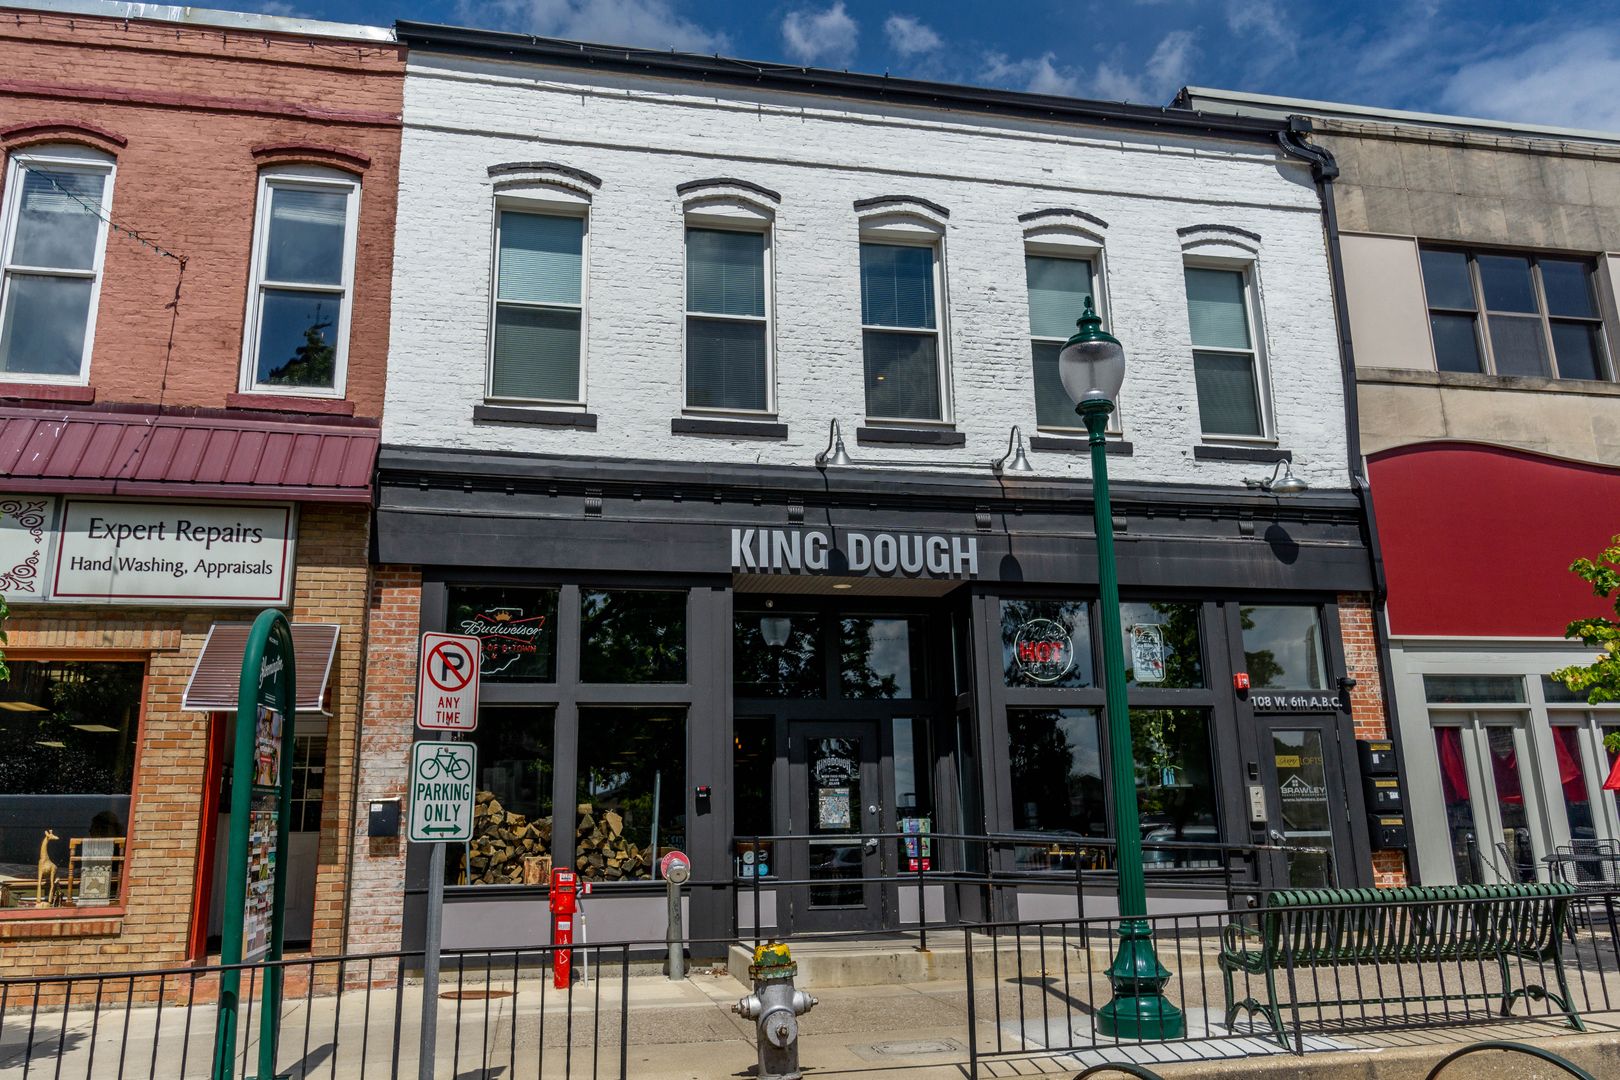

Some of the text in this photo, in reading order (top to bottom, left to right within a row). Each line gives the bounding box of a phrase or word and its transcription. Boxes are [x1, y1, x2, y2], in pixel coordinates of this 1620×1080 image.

[88, 518, 263, 549] Expert Repairs
[731, 528, 979, 575] KING DOUGH
[70, 557, 273, 578] Hand Washing, Appraisals
[461, 620, 542, 636] Budweiser
[1019, 640, 1064, 662] HOT
[437, 696, 460, 708] ANY
[1251, 696, 1343, 707] 108 W. 6th A.B.C.
[436, 711, 460, 724] TIME
[417, 783, 470, 801] PARKING
[1281, 786, 1325, 794] BRAWLEY
[424, 803, 461, 822] ONLY
